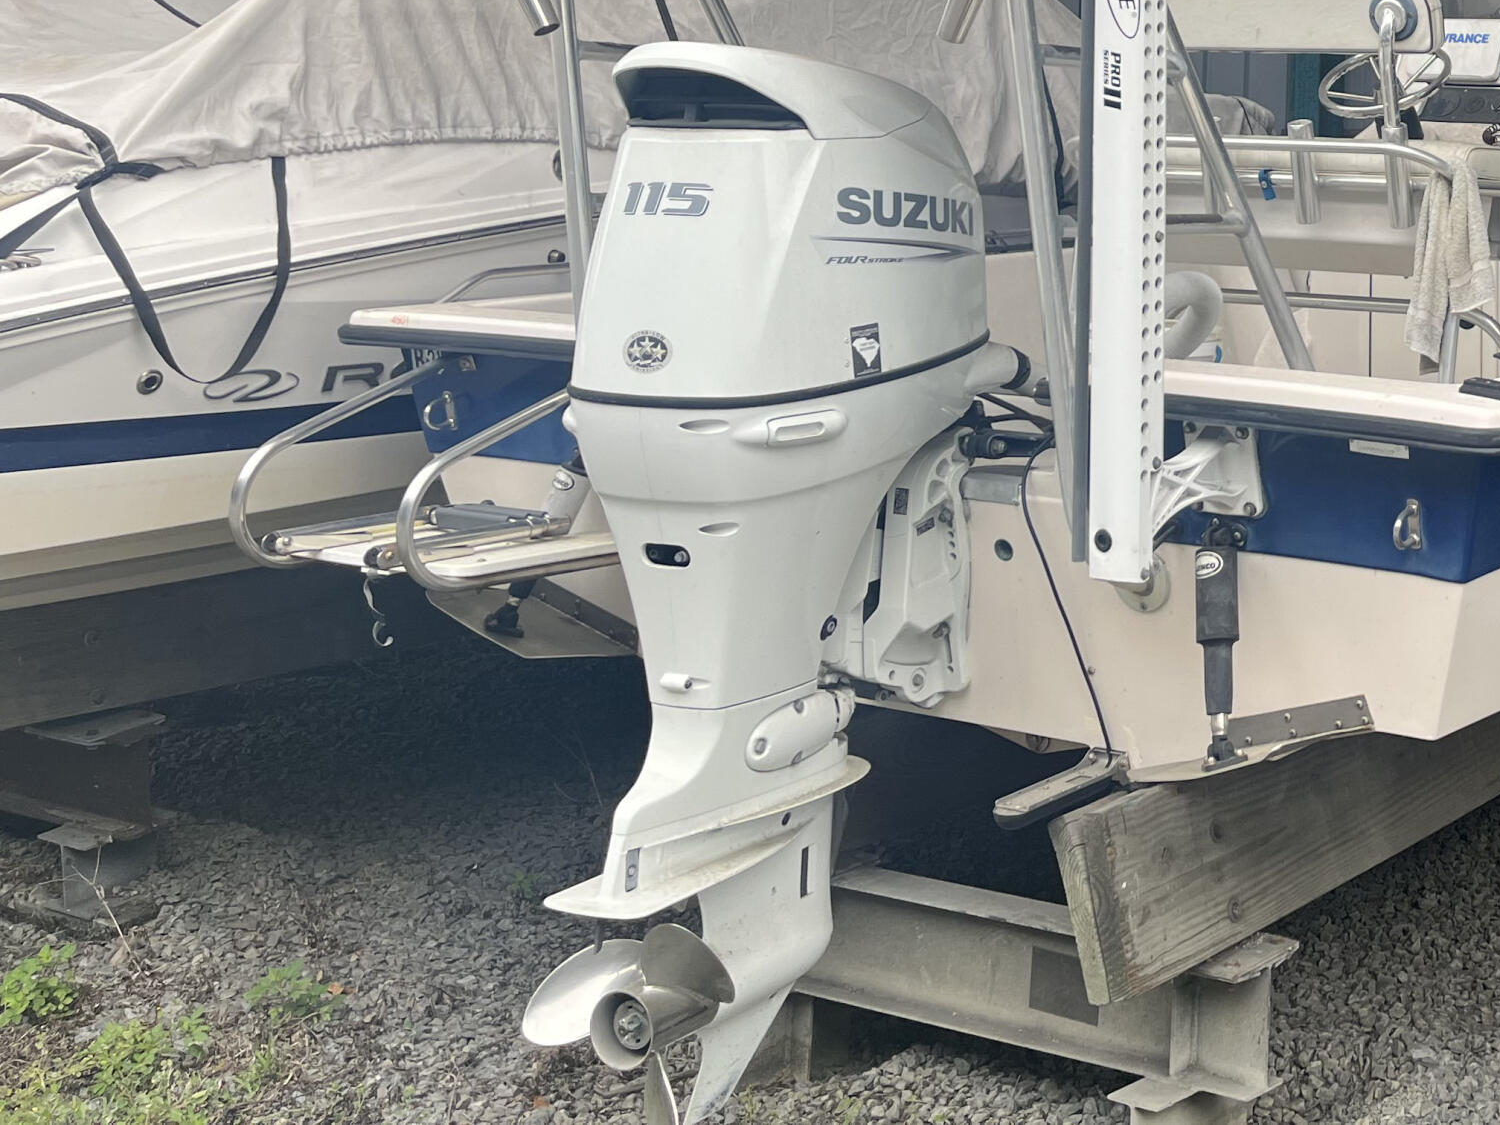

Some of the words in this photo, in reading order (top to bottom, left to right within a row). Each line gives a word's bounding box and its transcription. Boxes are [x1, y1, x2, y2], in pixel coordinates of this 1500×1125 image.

[1443, 32, 1491, 44] RANCE
[1109, 51, 1121, 88] PRO
[623, 181, 714, 217] 115
[836, 186, 975, 237] SUZUKI
[825, 255, 869, 265] FOUR
